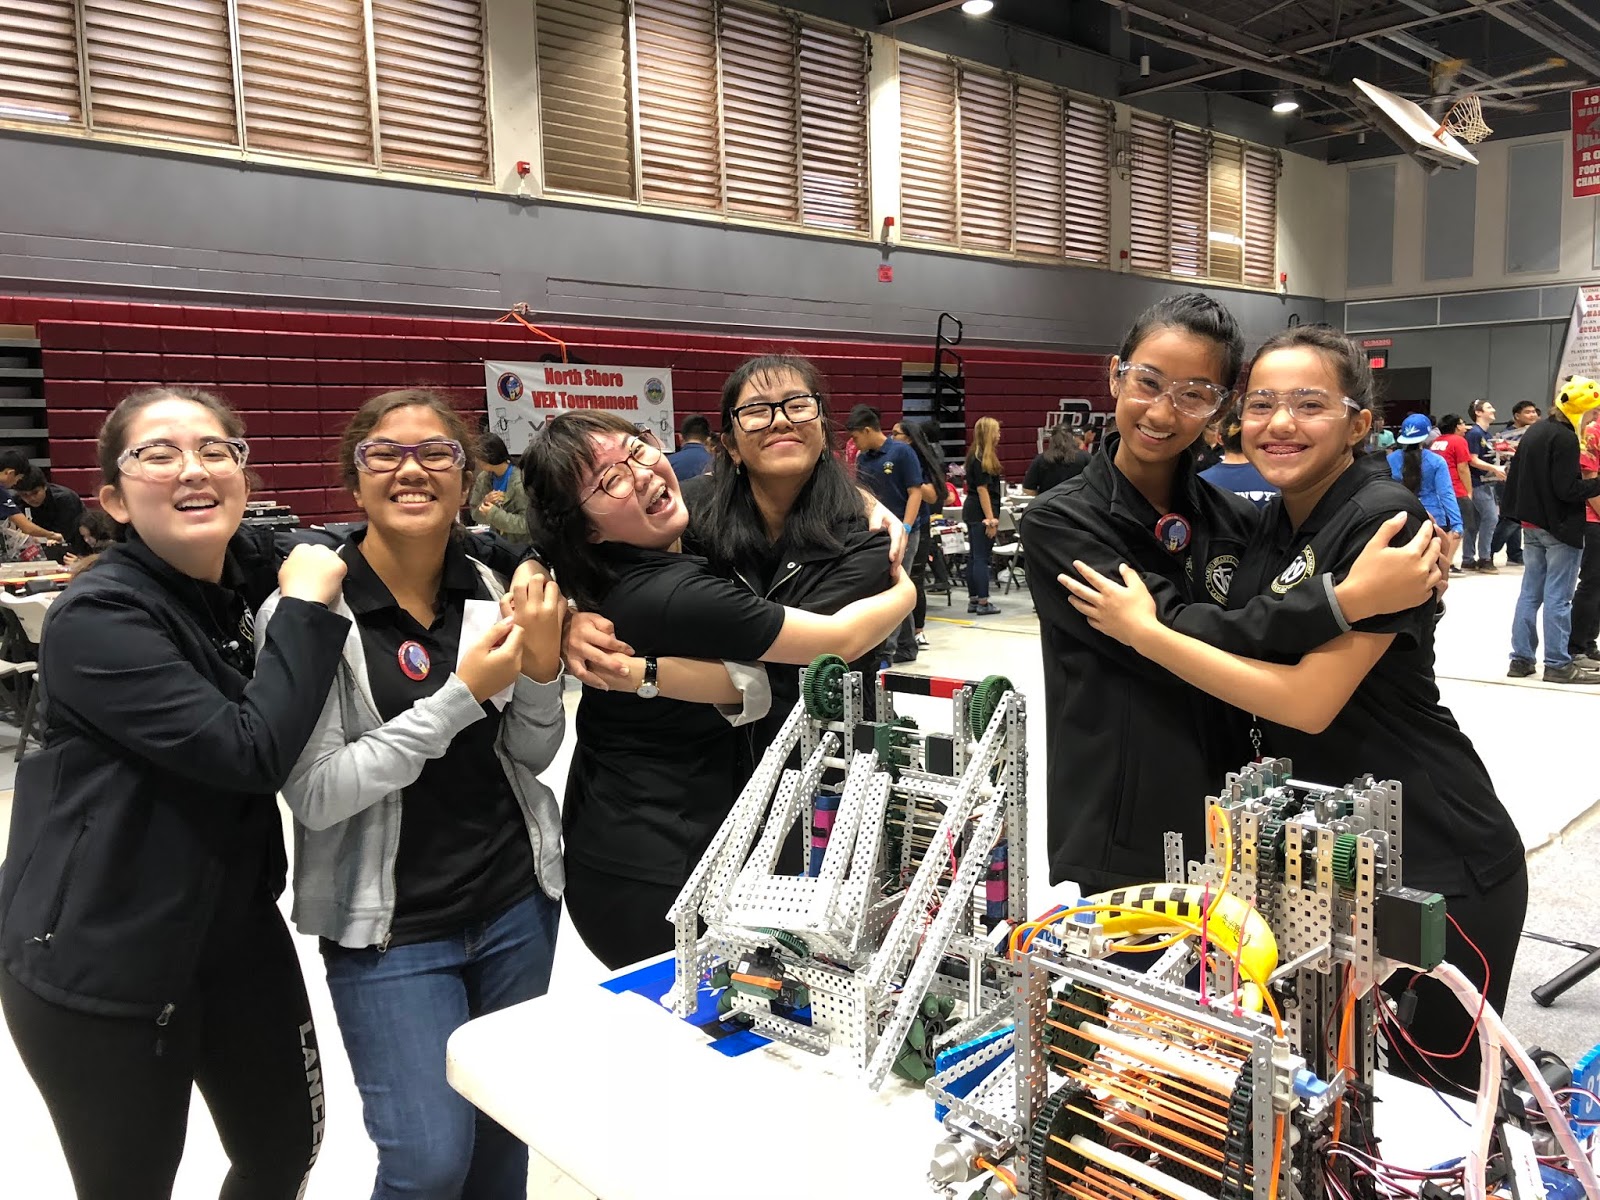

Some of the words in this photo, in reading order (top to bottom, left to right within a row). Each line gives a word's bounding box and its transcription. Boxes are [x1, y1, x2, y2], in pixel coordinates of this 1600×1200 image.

[544, 367, 582, 385] North
[584, 368, 623, 387] Shore
[531, 391, 558, 408] VEX
[558, 392, 638, 410] Tournament
